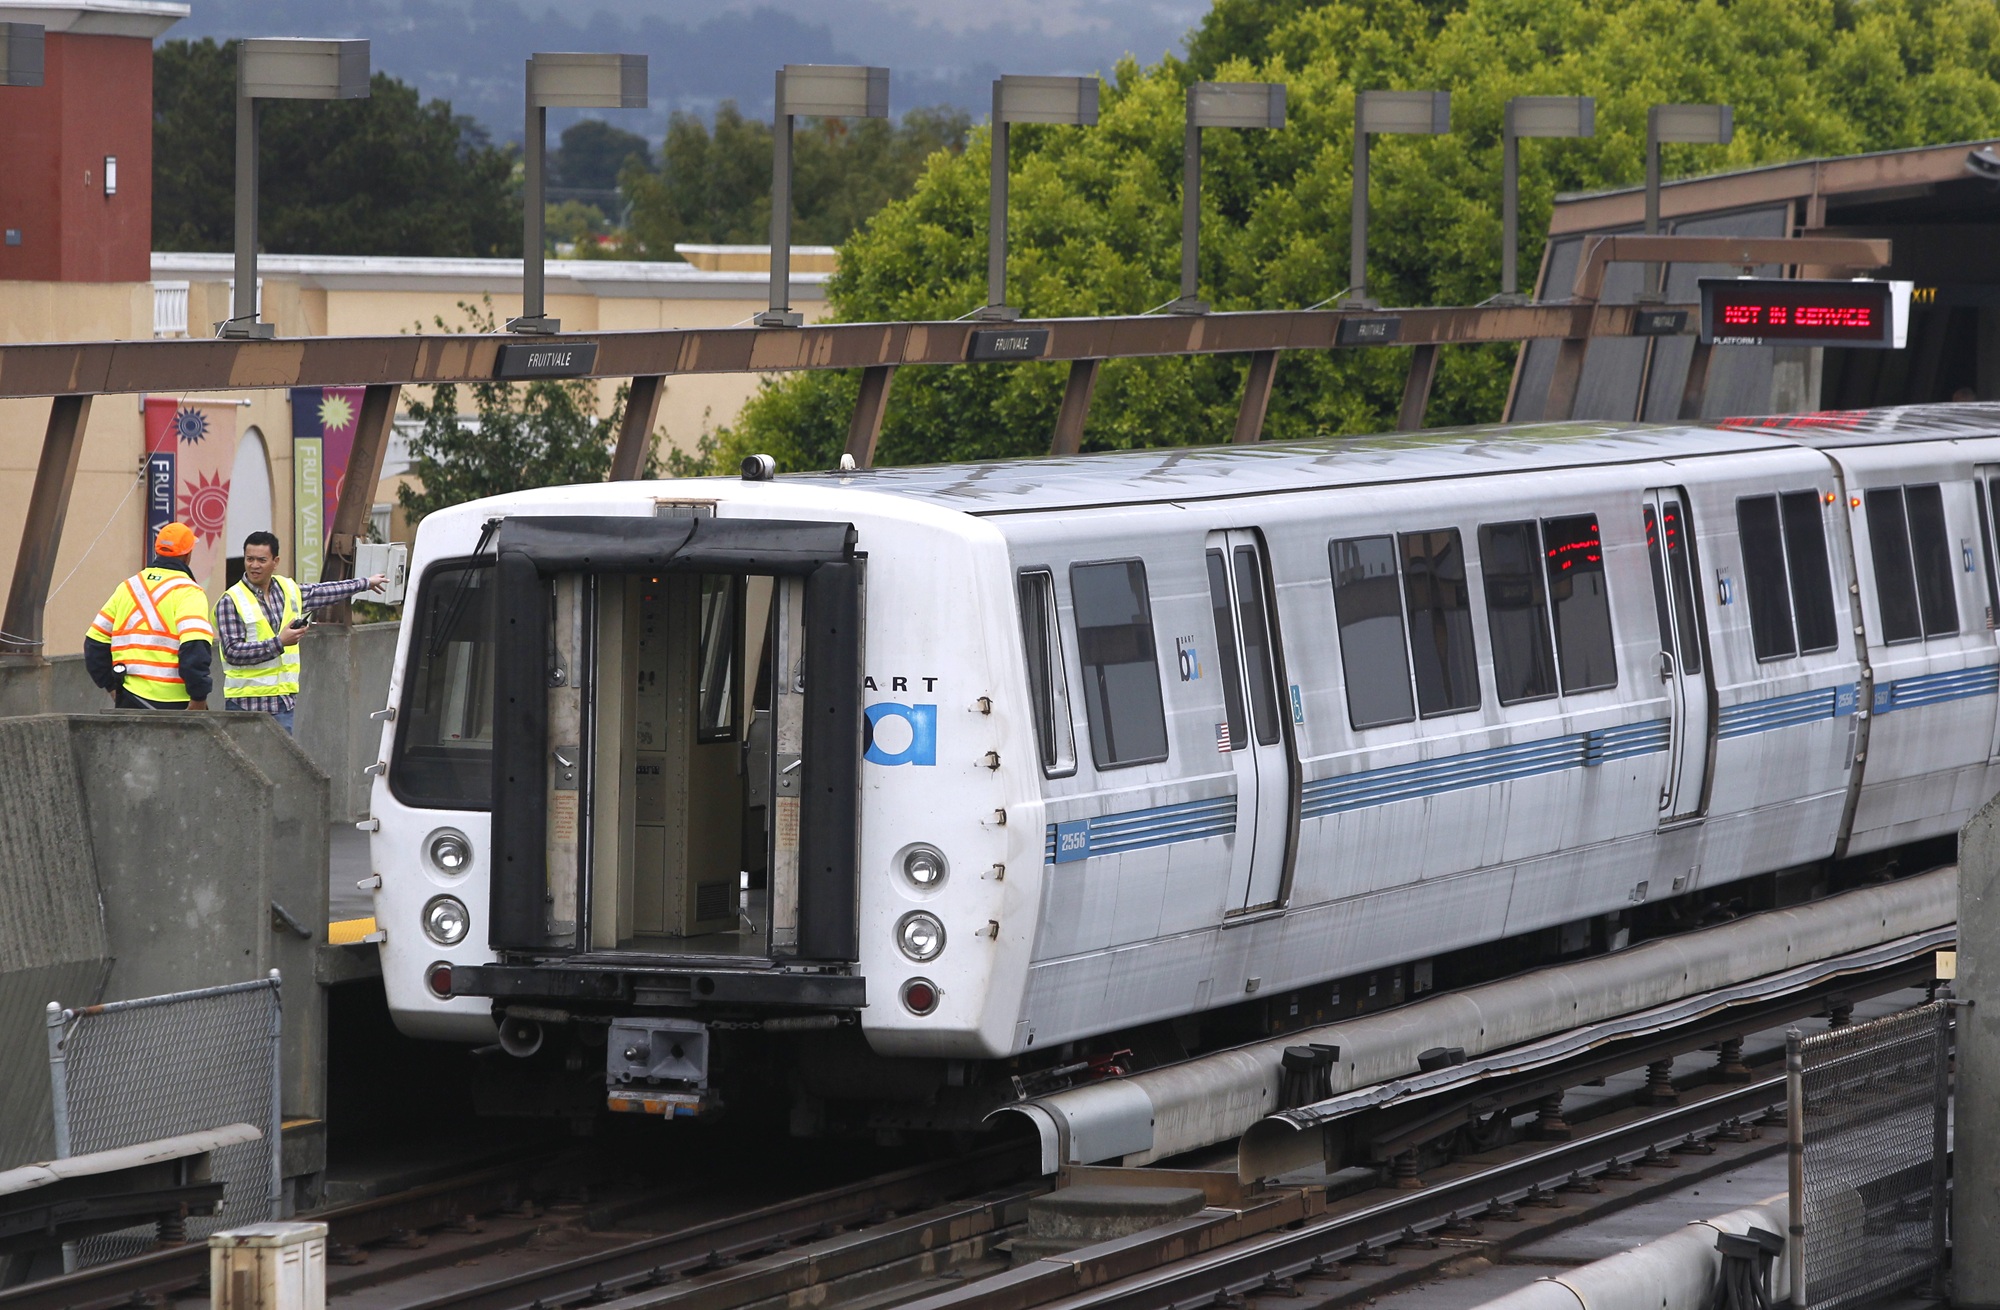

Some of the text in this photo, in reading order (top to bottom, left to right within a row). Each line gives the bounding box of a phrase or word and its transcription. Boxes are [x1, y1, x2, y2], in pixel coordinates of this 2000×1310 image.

[1912, 287, 1938, 304] XIT
[1724, 305, 1871, 326] NOT IN SERVICE
[994, 337, 1029, 351] FRUITVALE
[1713, 336, 1763, 345] PLATFORM 2
[528, 352, 572, 368] FRUITVALE
[299, 446, 318, 497] FRUIT
[152, 460, 170, 515] FRUIT
[300, 503, 318, 546] VALE
[865, 676, 939, 692] ART
[1061, 831, 1086, 851] 2556
